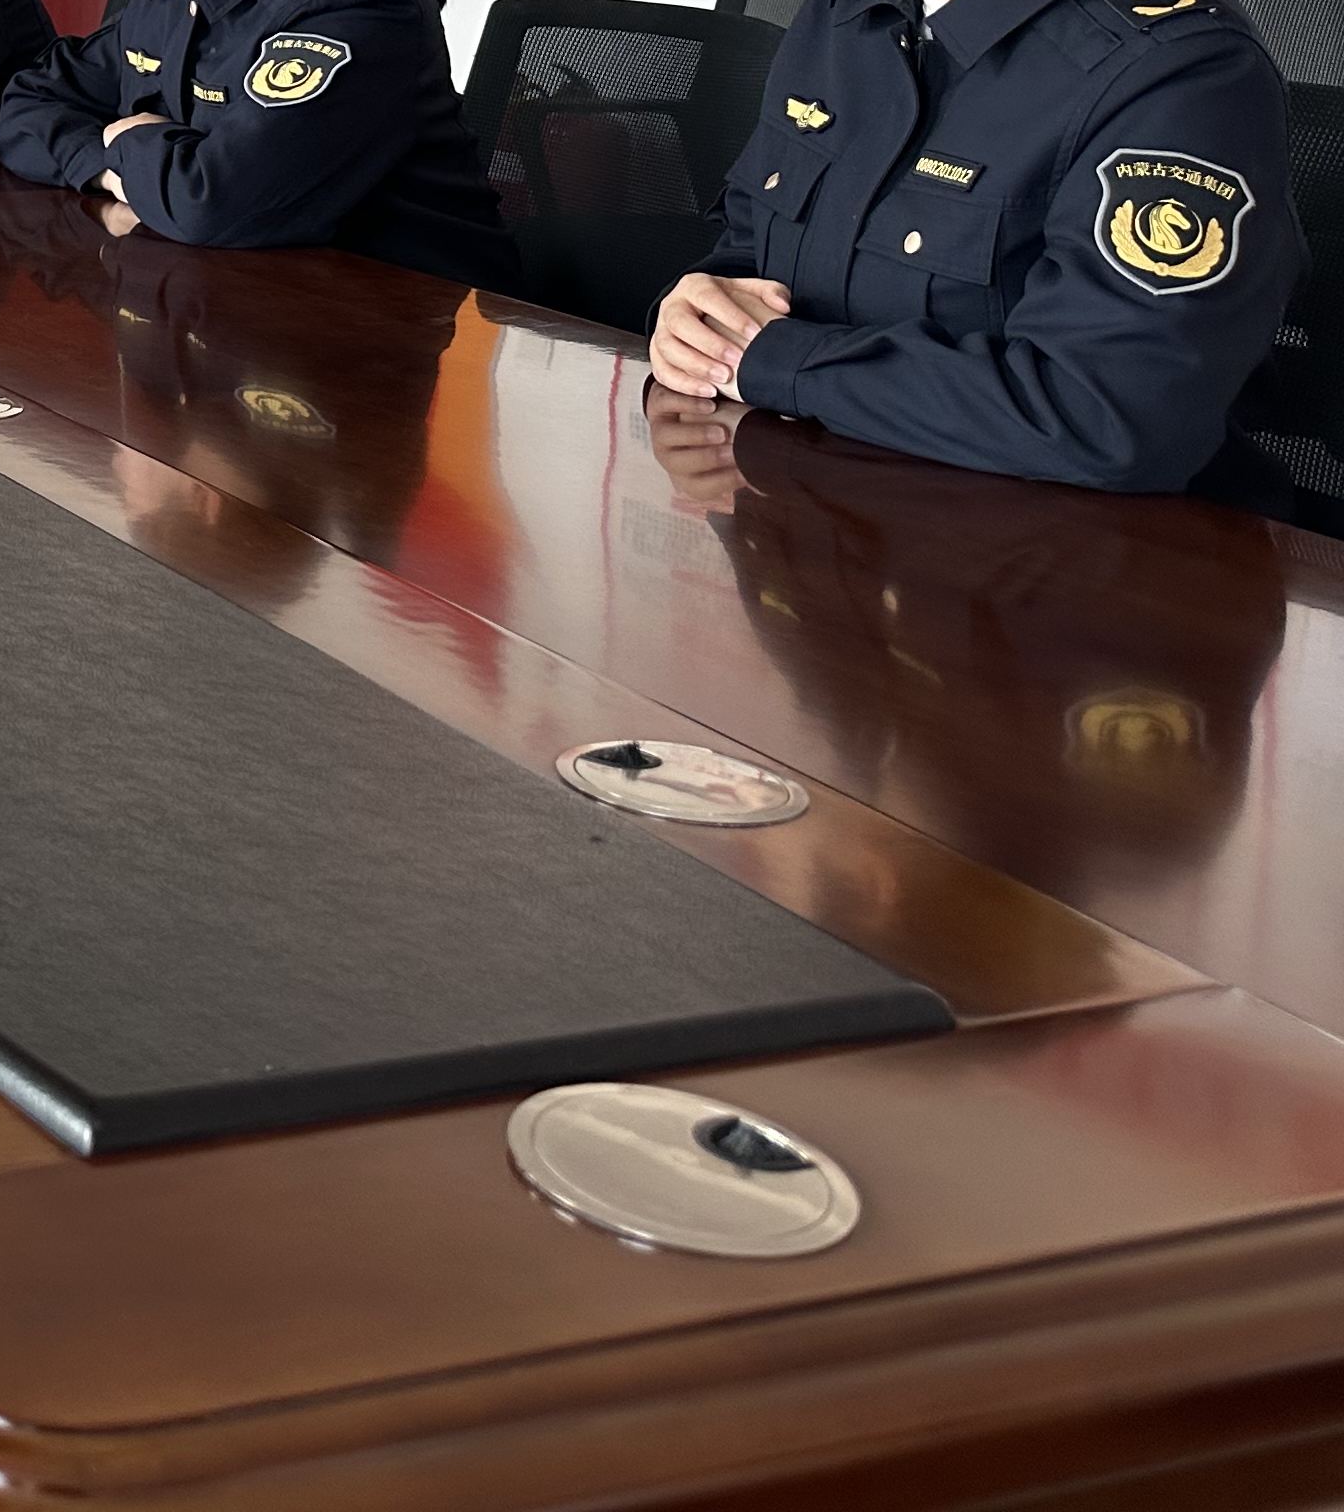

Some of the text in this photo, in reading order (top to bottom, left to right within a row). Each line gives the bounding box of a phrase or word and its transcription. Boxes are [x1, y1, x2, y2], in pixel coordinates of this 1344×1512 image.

[1115, 161, 1237, 201] 内蒙古交通集团
